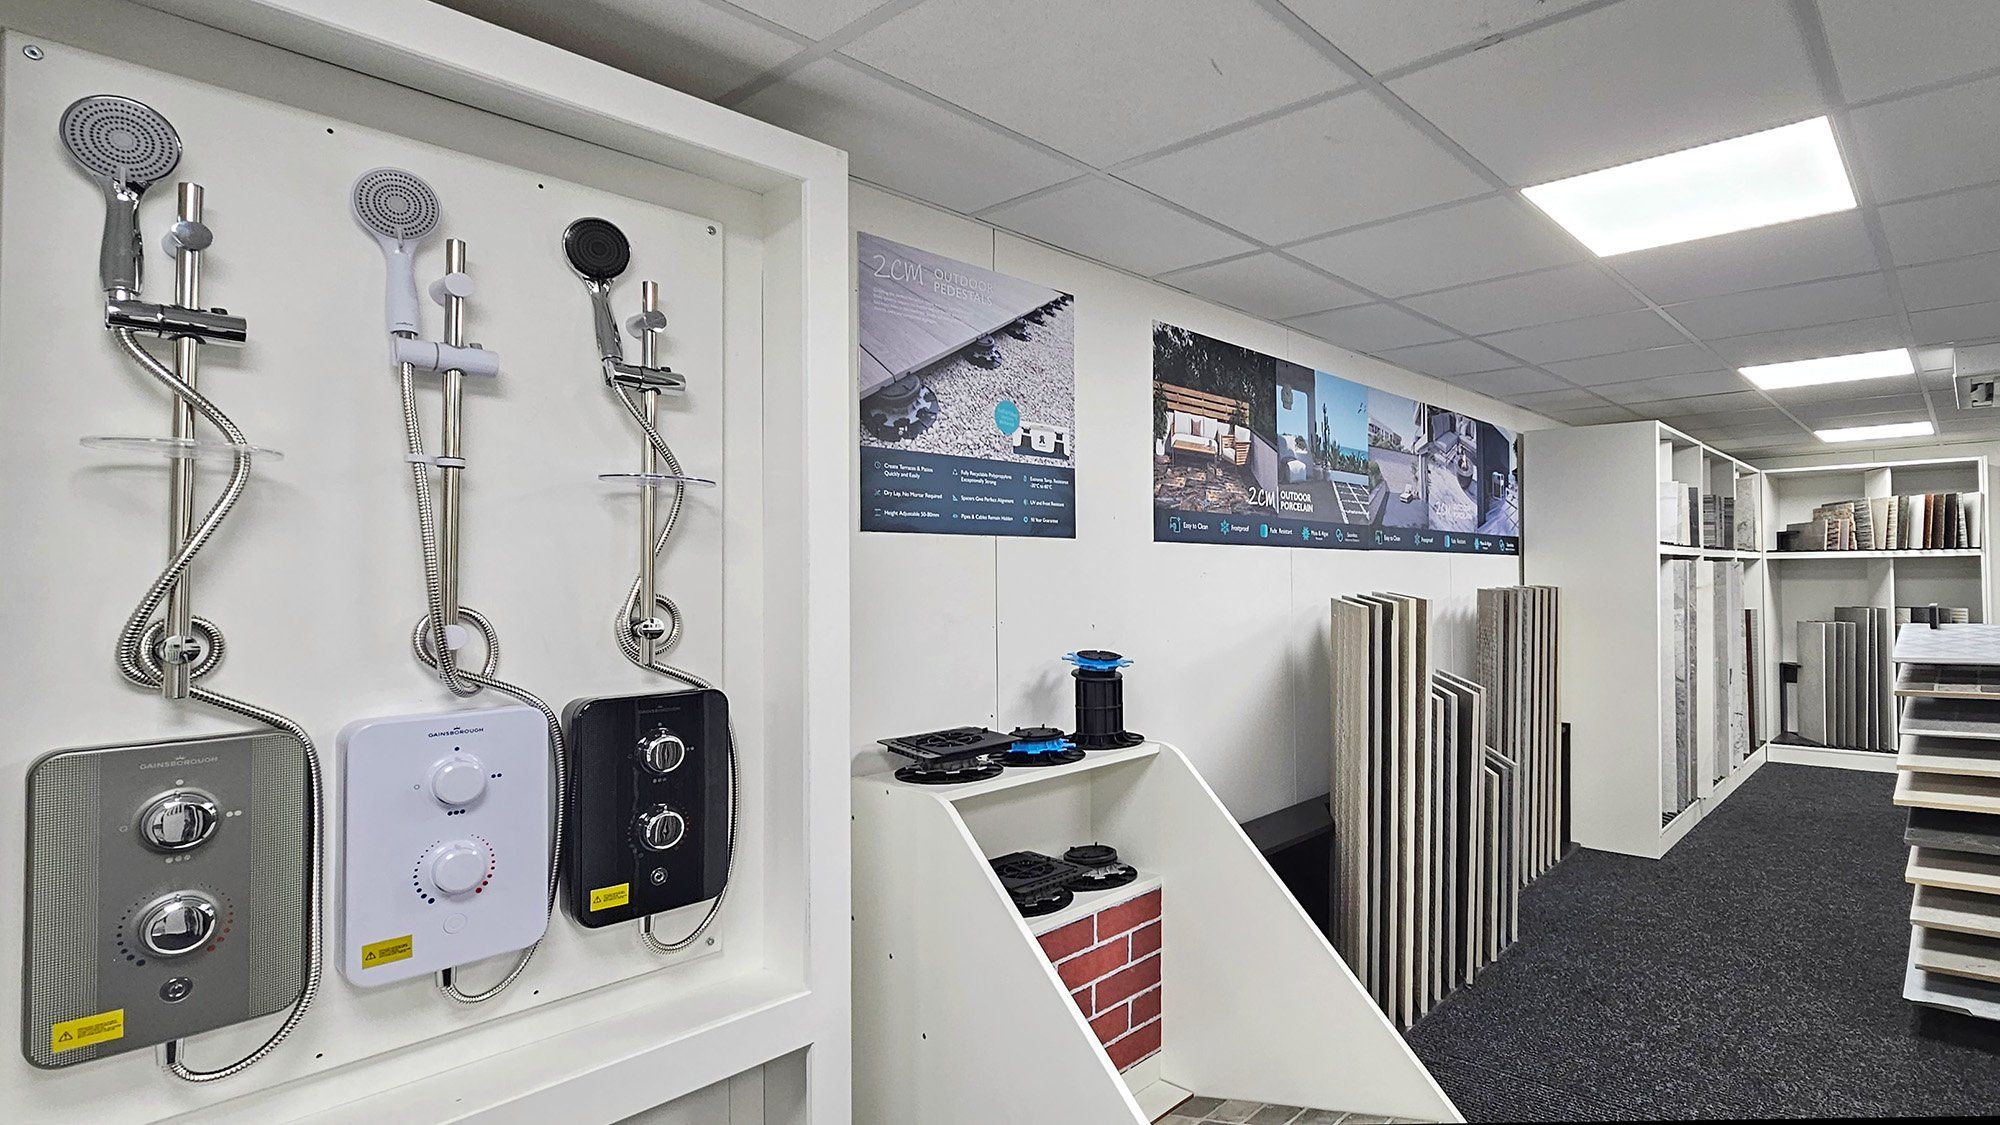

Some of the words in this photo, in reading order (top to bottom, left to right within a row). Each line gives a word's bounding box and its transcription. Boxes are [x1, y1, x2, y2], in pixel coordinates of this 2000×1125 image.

[873, 254, 924, 286] 2CM
[934, 268, 994, 294] OUTDOOR
[933, 281, 993, 307] PEDESTALS
[1248, 486, 1276, 510] 2CM
[1280, 490, 1312, 502] OUTDOOR
[1280, 501, 1314, 512] PORCELAIN
[1183, 522, 1192, 530] Easy
[428, 728, 484, 738] GAINSBOROUGH
[140, 756, 218, 770] GAINSBOROUGH
